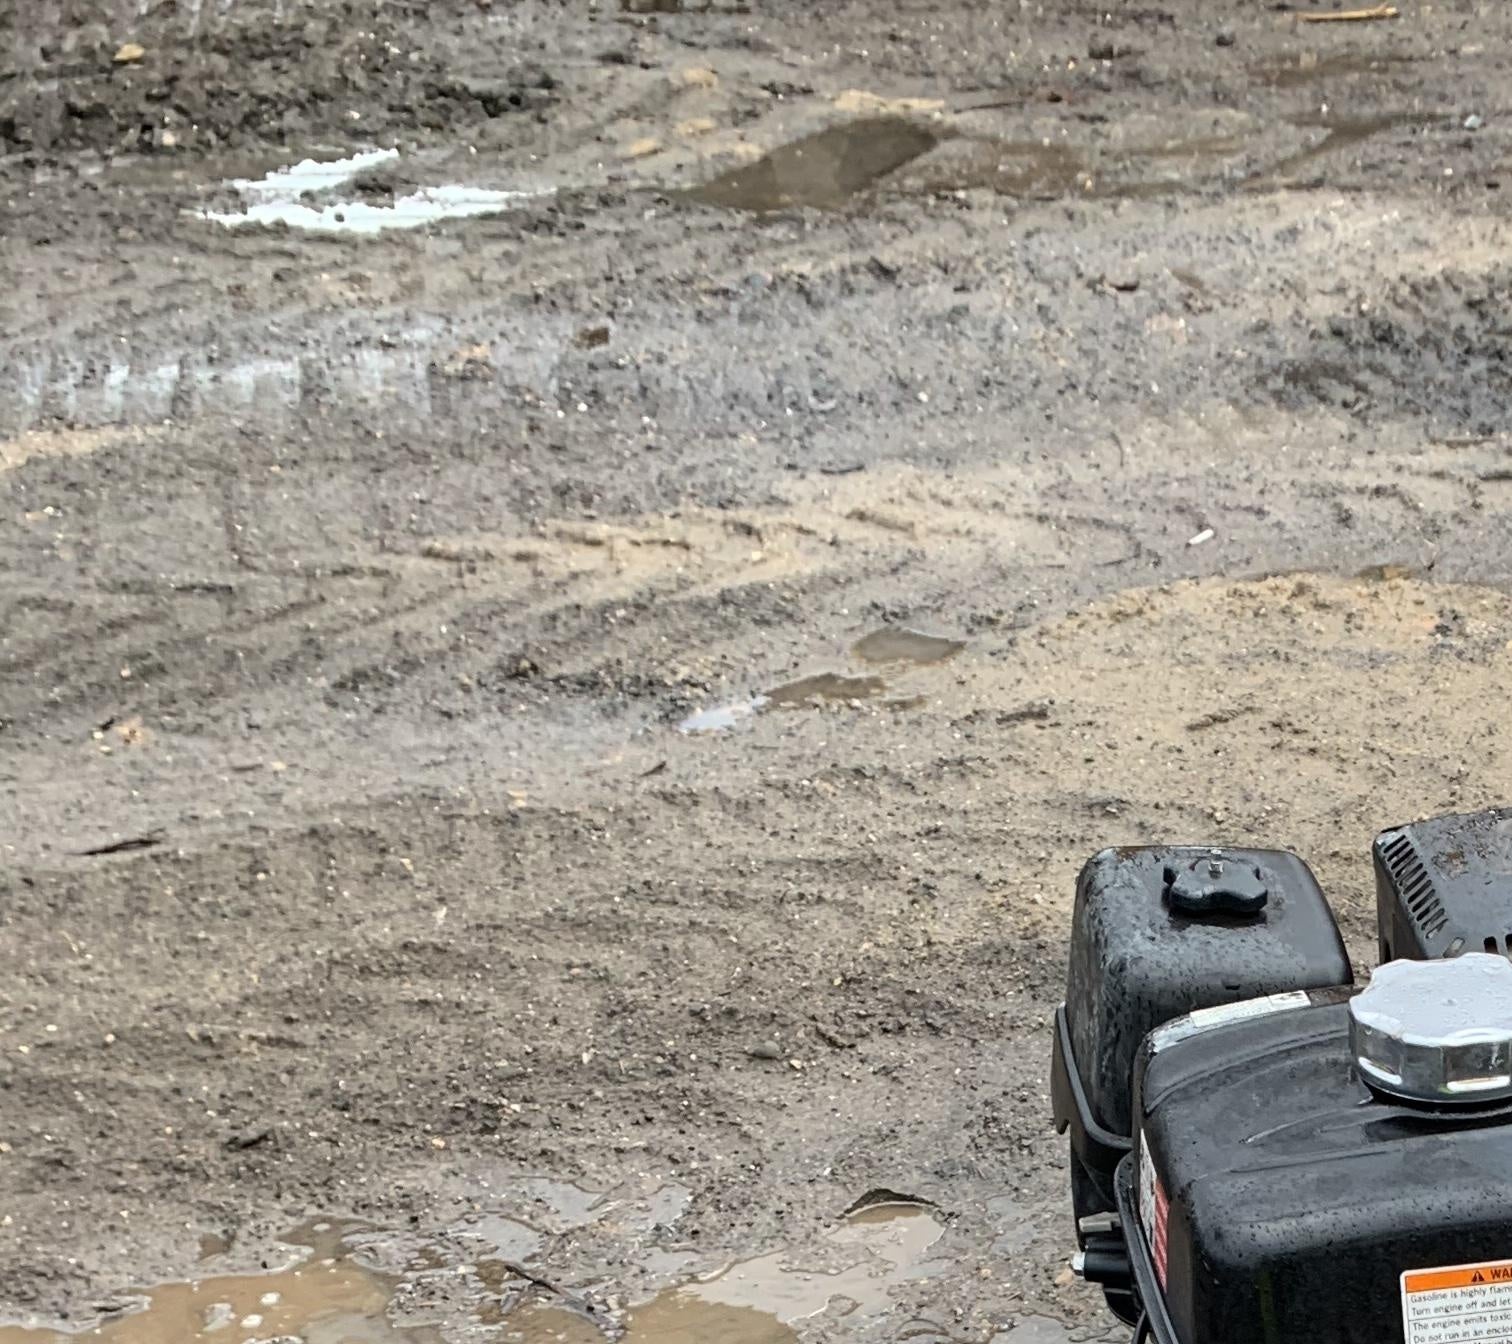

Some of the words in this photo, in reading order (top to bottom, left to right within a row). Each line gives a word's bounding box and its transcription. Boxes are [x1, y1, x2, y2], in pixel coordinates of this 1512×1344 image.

[1410, 1292, 1447, 1303] Gasoline
[1450, 1290, 1457, 1299] is
[1460, 1287, 1487, 1298] highly
[1411, 1307, 1431, 1316] Turn
[1433, 1304, 1463, 1313] engine
[1465, 1301, 1478, 1309] off
[1481, 1299, 1497, 1308] and
[1499, 1298, 1510, 1306] let
[1413, 1323, 1429, 1331] The
[1431, 1320, 1460, 1329] engine
[1463, 1316, 1487, 1325] emits
[1490, 1313, 1511, 1321] toxic
[1413, 1336, 1426, 1344] Do
[1429, 1333, 1442, 1342] not
[1444, 1332, 1460, 1340] run
[1472, 1329, 1483, 1337] an
